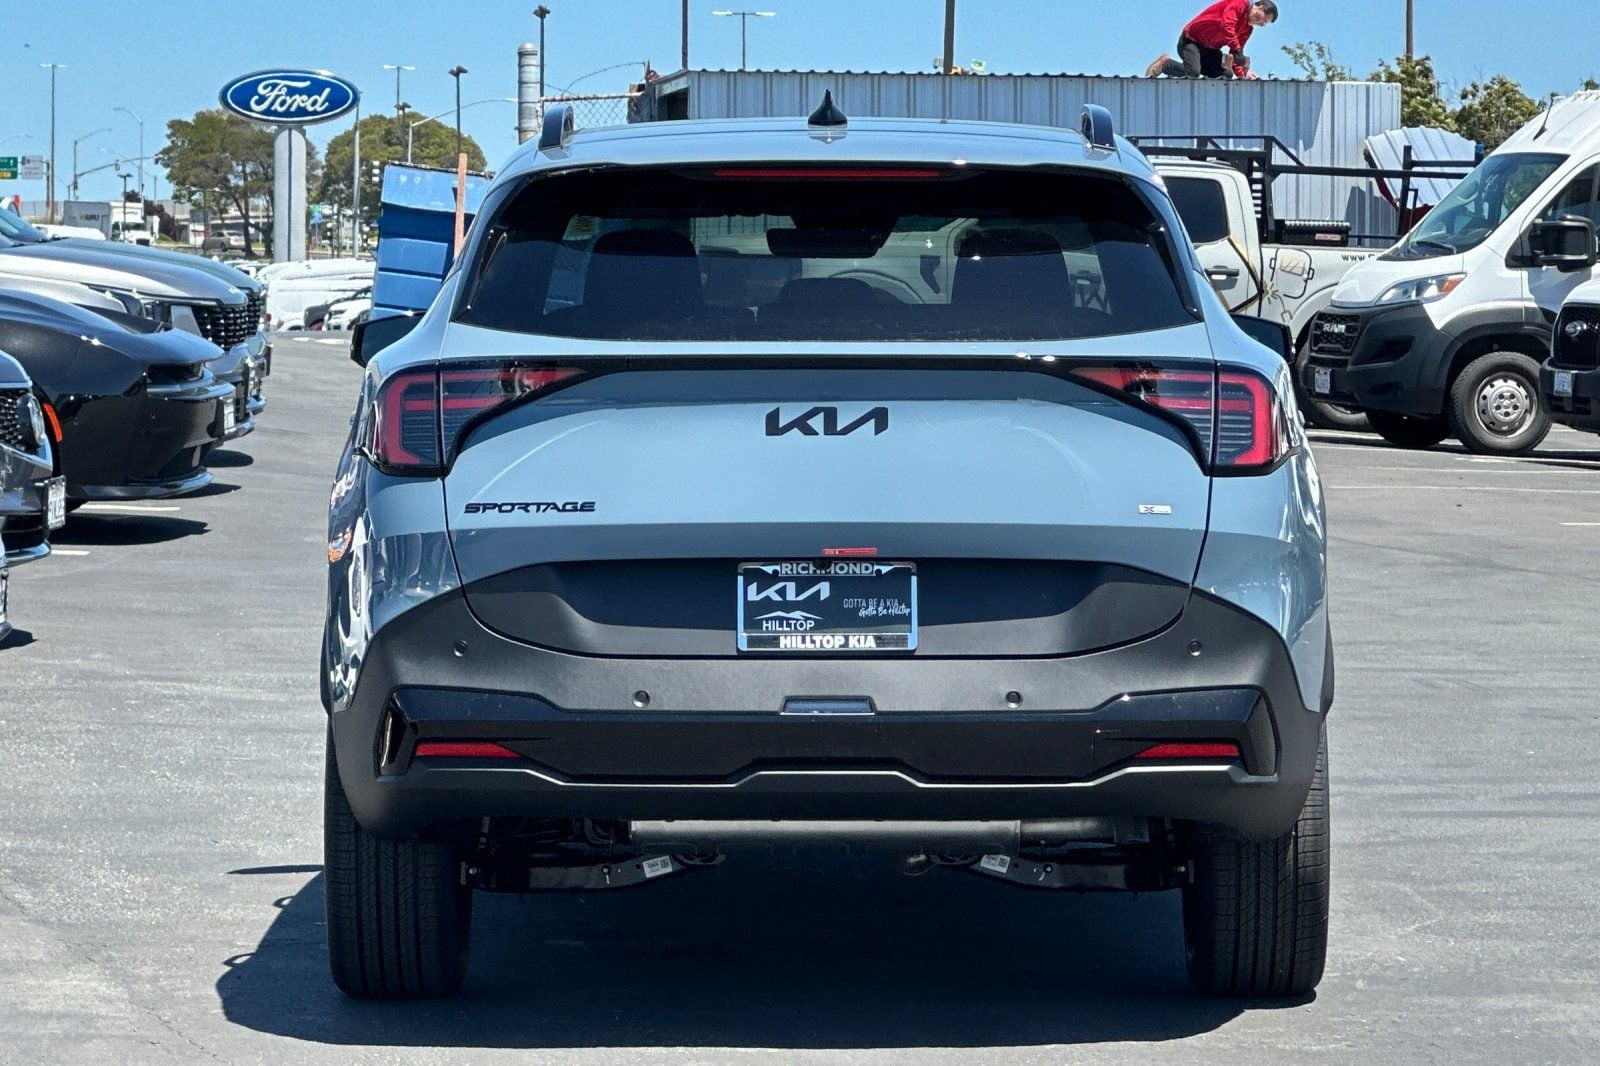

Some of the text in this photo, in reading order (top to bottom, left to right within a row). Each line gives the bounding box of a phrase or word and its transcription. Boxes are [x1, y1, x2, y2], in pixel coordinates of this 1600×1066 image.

[250, 79, 331, 112] Ford
[1323, 323, 1346, 333] RAM
[765, 406, 889, 436] KIA
[464, 501, 596, 514] SPORTAGE
[747, 581, 831, 601] KIA
[843, 598, 867, 608] GOTTA
[868, 598, 878, 608] BE
[886, 598, 899, 608] KIA
[762, 619, 815, 631] HILLTOP
[779, 635, 877, 649] HILLTOP KIA
